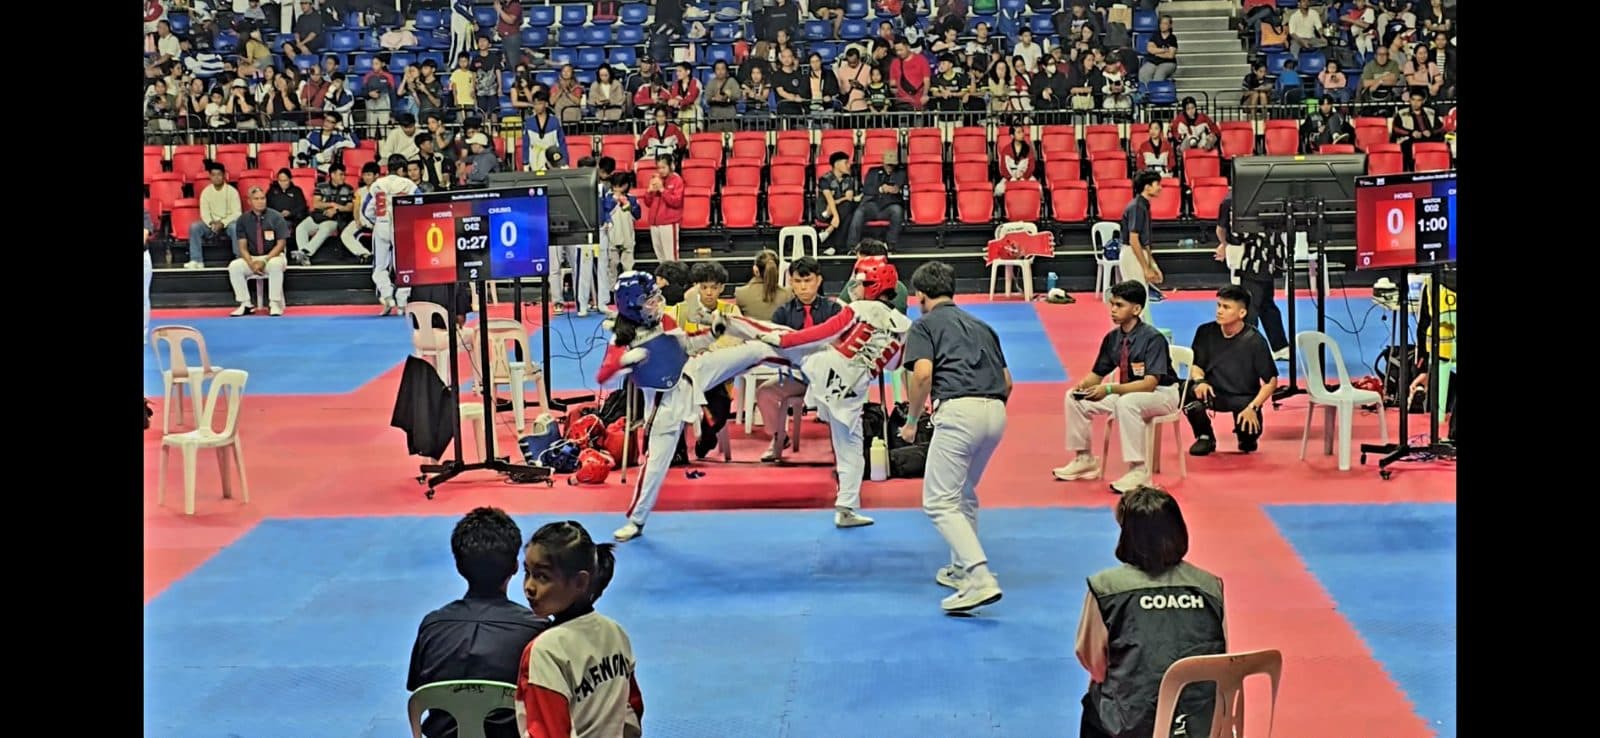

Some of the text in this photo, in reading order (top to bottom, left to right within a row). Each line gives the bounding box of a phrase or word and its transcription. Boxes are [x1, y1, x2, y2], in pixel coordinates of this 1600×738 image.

[1387, 208, 1404, 235] 0
[1417, 216, 1448, 232] 1:00
[427, 226, 443, 253] 0
[501, 221, 517, 247] 0
[457, 235, 488, 250] 0:27
[1363, 256, 1370, 265] 0
[1429, 251, 1435, 260] 1
[470, 268, 478, 279] 2
[536, 263, 543, 272] 0
[403, 274, 410, 283] 0
[1139, 594, 1205, 609] COACH
